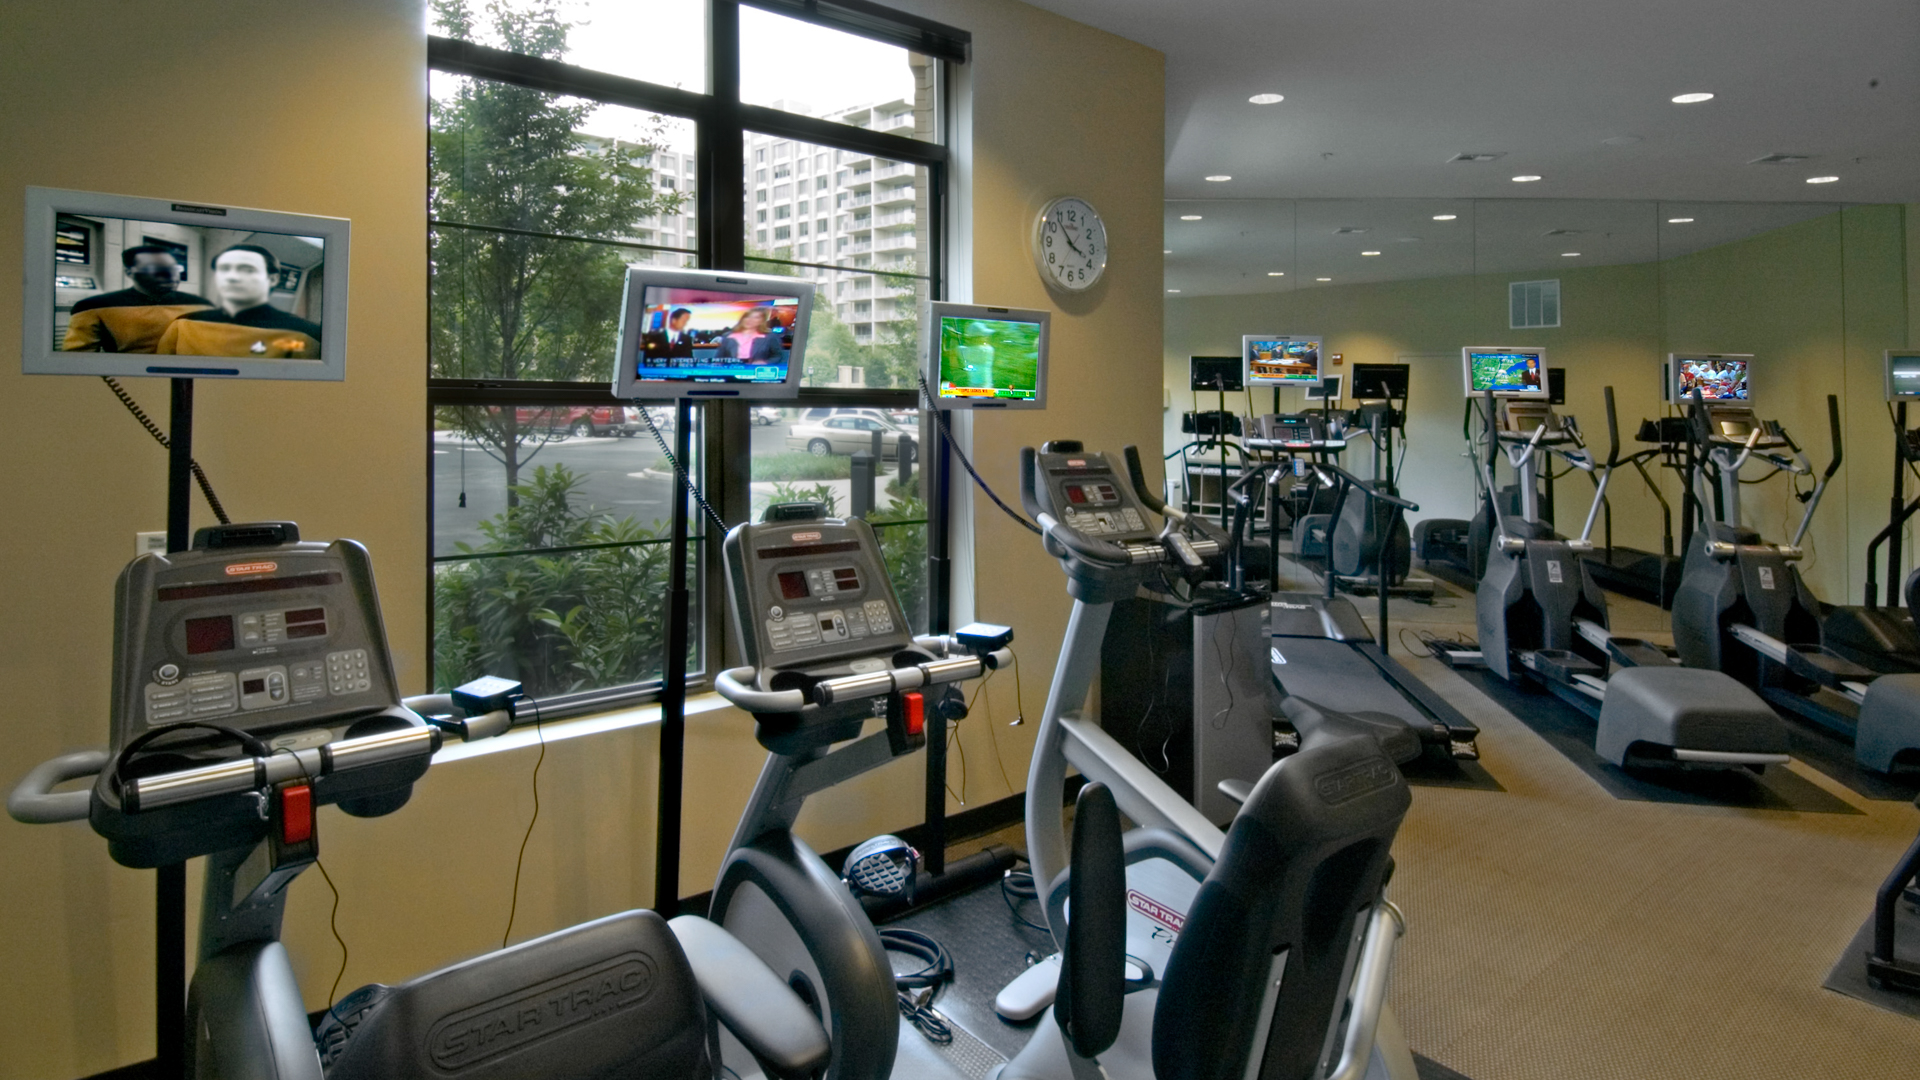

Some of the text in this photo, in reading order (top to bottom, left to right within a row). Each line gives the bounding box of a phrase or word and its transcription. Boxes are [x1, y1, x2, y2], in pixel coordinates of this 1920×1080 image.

[1056, 211, 1063, 223] 11
[1067, 210, 1076, 222] 12
[1048, 221, 1057, 233] 10
[1086, 228, 1092, 240] 2
[1046, 236, 1052, 247] 9
[1089, 244, 1095, 255] 3
[1049, 252, 1055, 264] 8
[1086, 259, 1092, 269] 4
[1058, 265, 1064, 277] 7
[1067, 270, 1074, 282] 6
[1078, 268, 1084, 280] 5
[1130, 896, 1158, 916] STAR
[437, 970, 642, 1060] STAR TRAC
